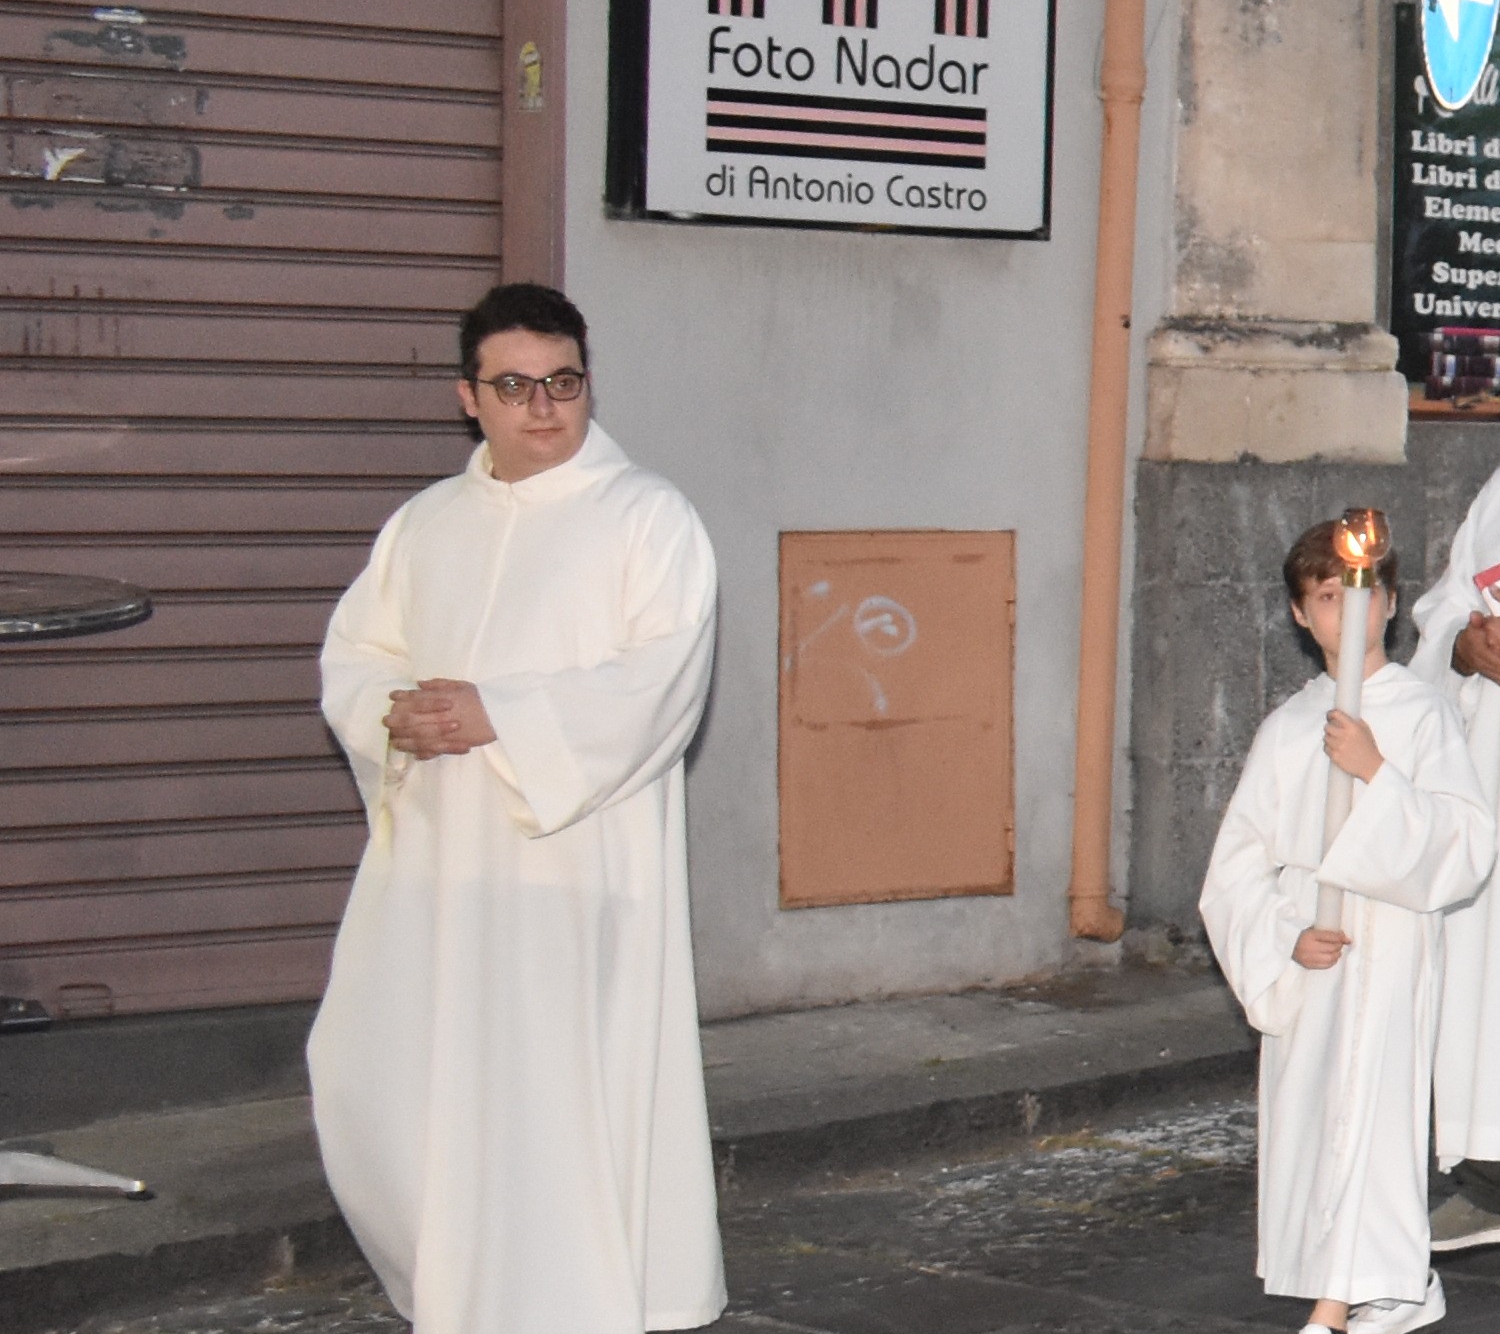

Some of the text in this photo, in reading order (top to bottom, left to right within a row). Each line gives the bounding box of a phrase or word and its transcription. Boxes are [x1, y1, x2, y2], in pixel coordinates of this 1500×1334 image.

[708, 26, 988, 95] Foto Nadar
[1411, 129, 1475, 155] Libri
[705, 165, 988, 212] di Antonio Castro
[1411, 163, 1476, 189] Libri
